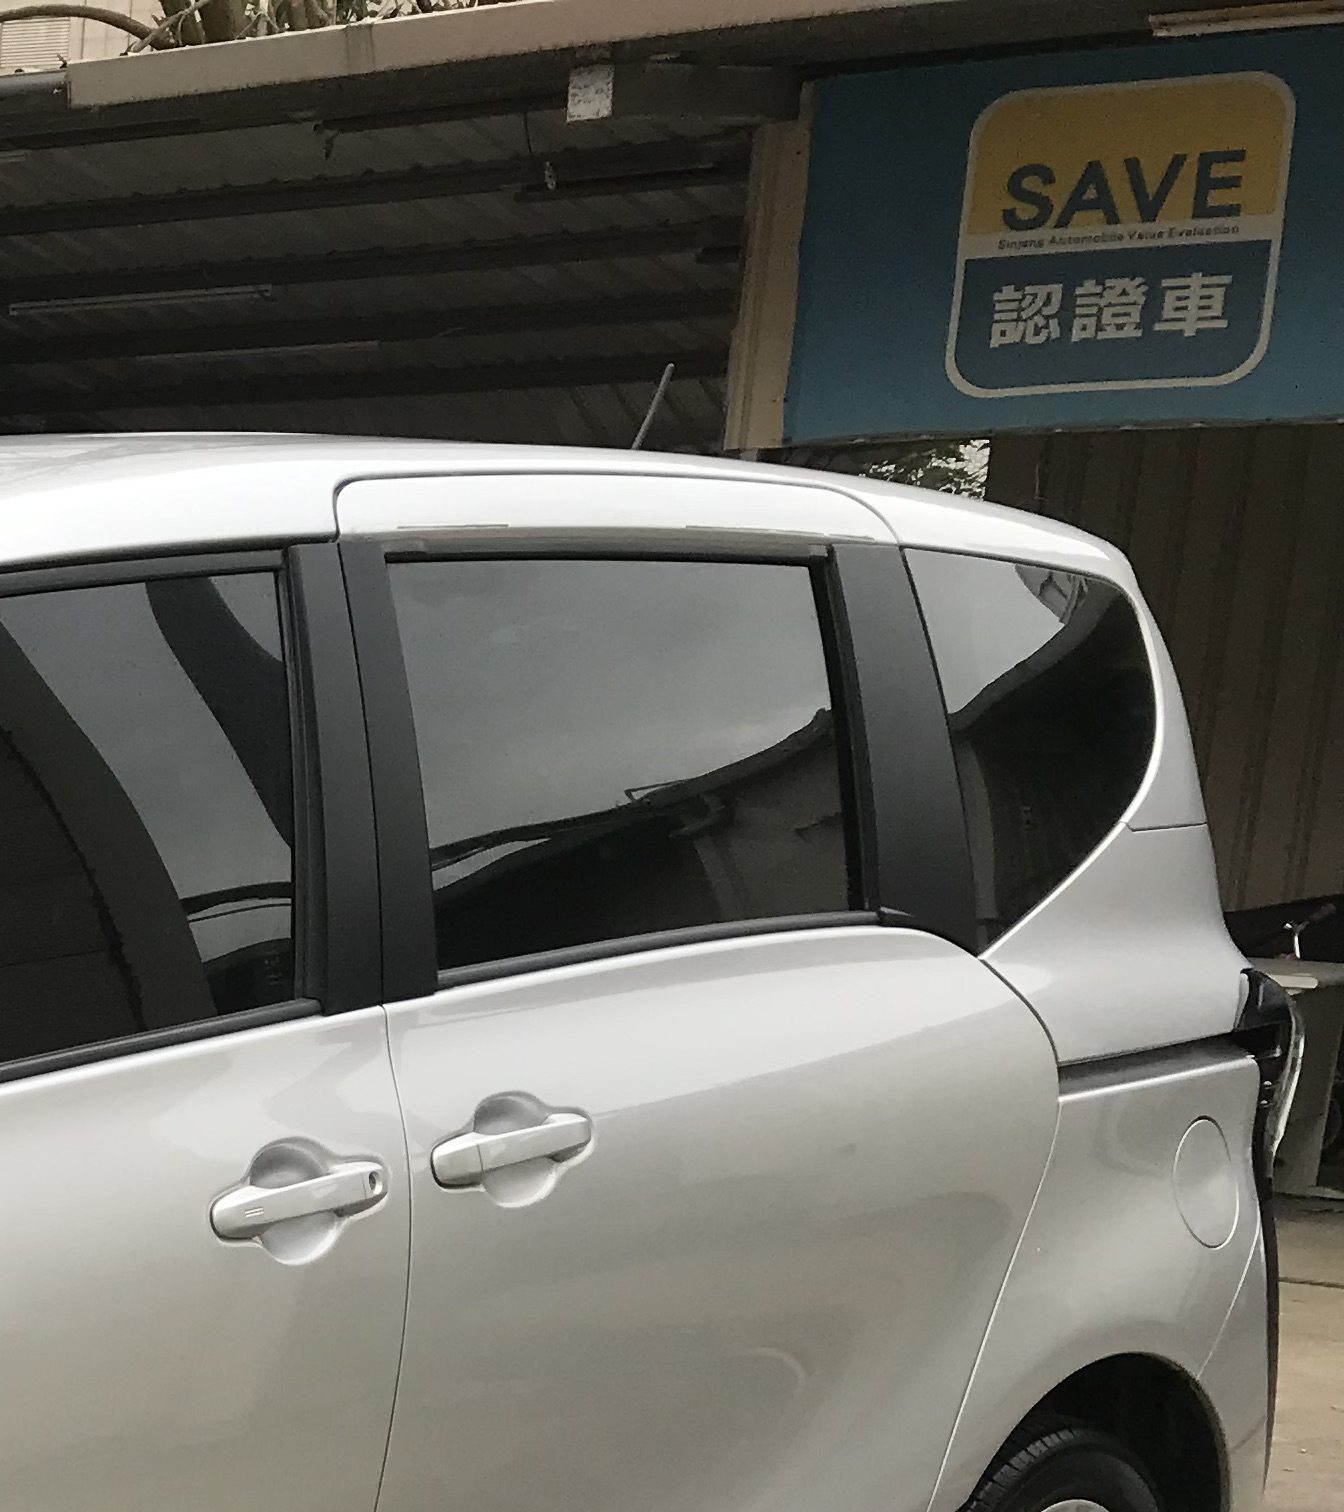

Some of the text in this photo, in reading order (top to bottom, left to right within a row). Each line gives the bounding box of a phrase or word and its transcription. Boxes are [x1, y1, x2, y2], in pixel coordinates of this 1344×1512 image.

[1002, 149, 1247, 231] SAVE
[989, 271, 1233, 348] 認證車
